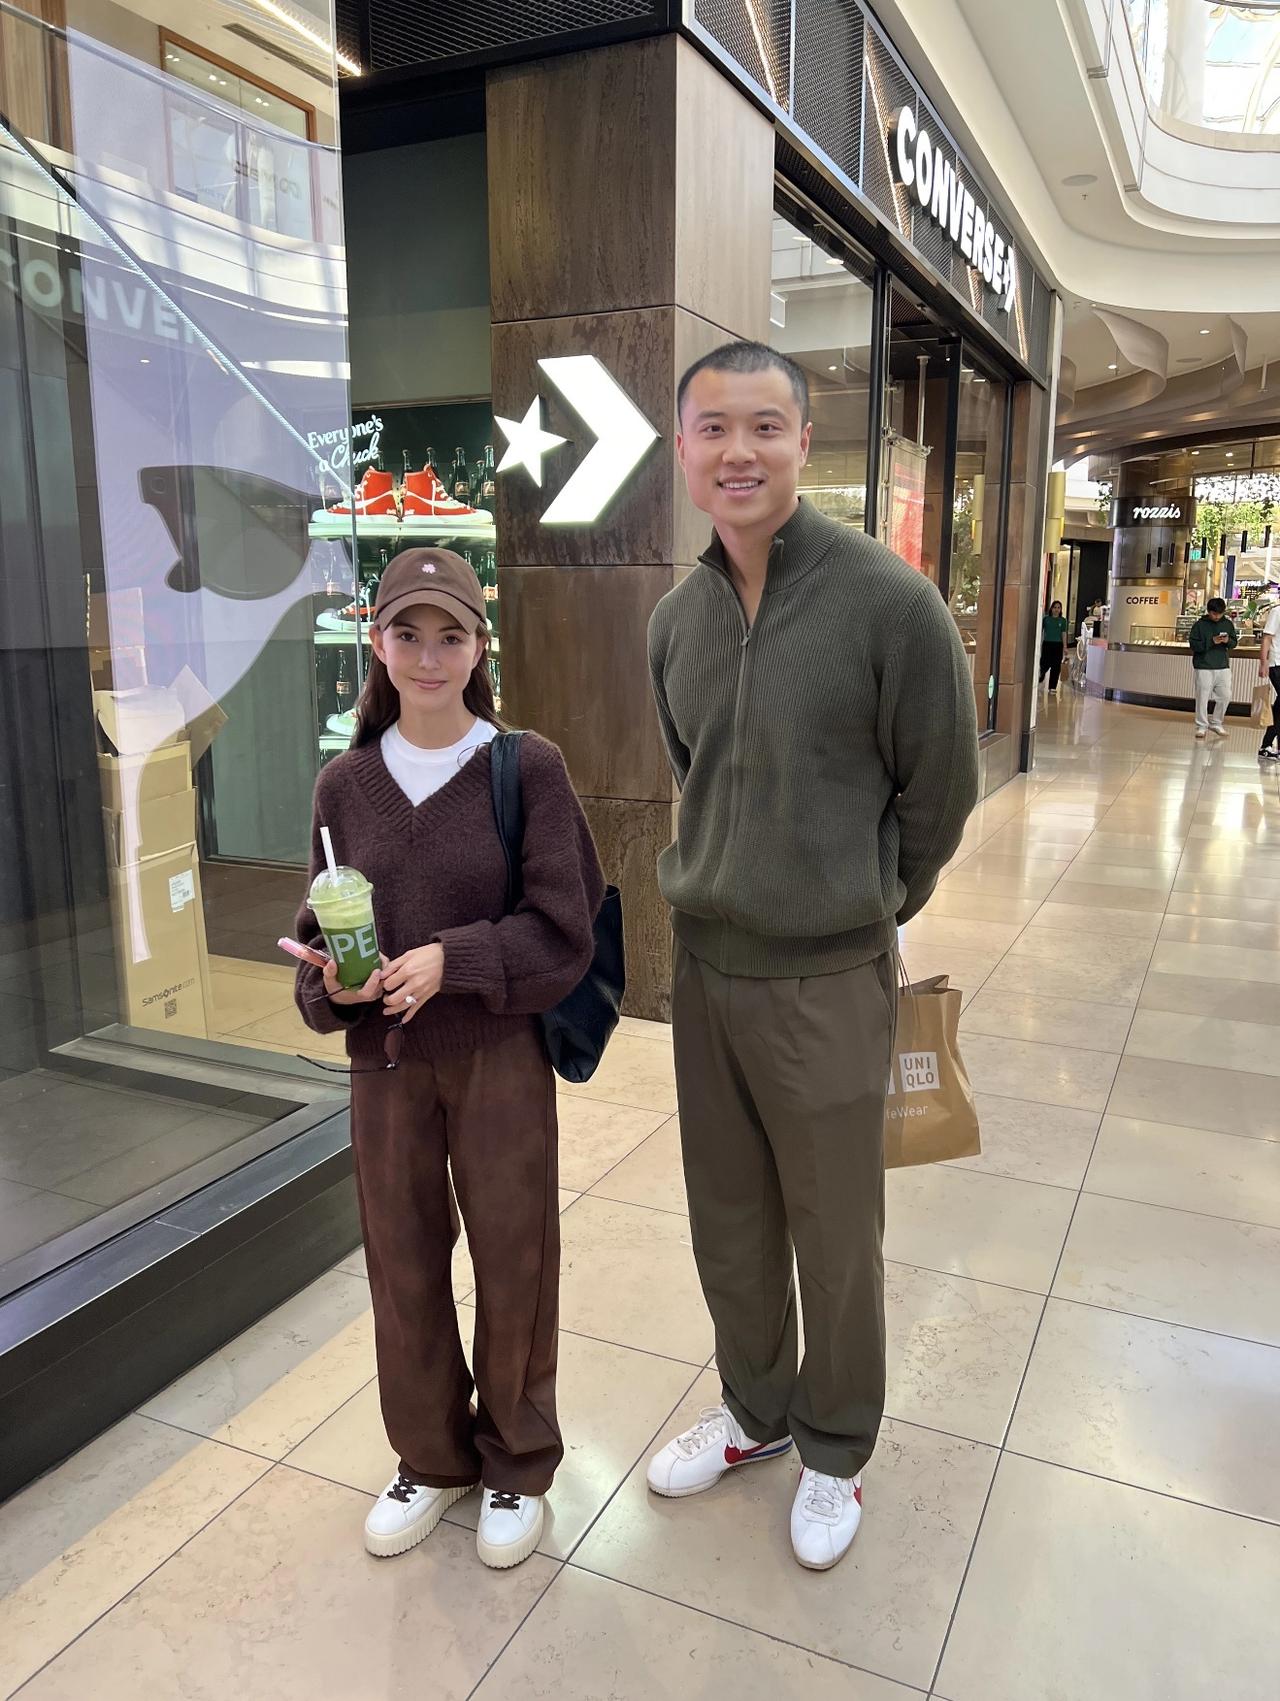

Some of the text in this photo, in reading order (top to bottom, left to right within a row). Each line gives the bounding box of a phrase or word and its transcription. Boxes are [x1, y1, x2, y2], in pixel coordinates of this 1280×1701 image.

[896, 105, 1005, 295] CONVERSE
[1133, 503, 1181, 519] rozzis
[1126, 596, 1160, 605] COFFEE
[903, 1056, 931, 1071] UNI
[906, 1071, 935, 1088] QLO
